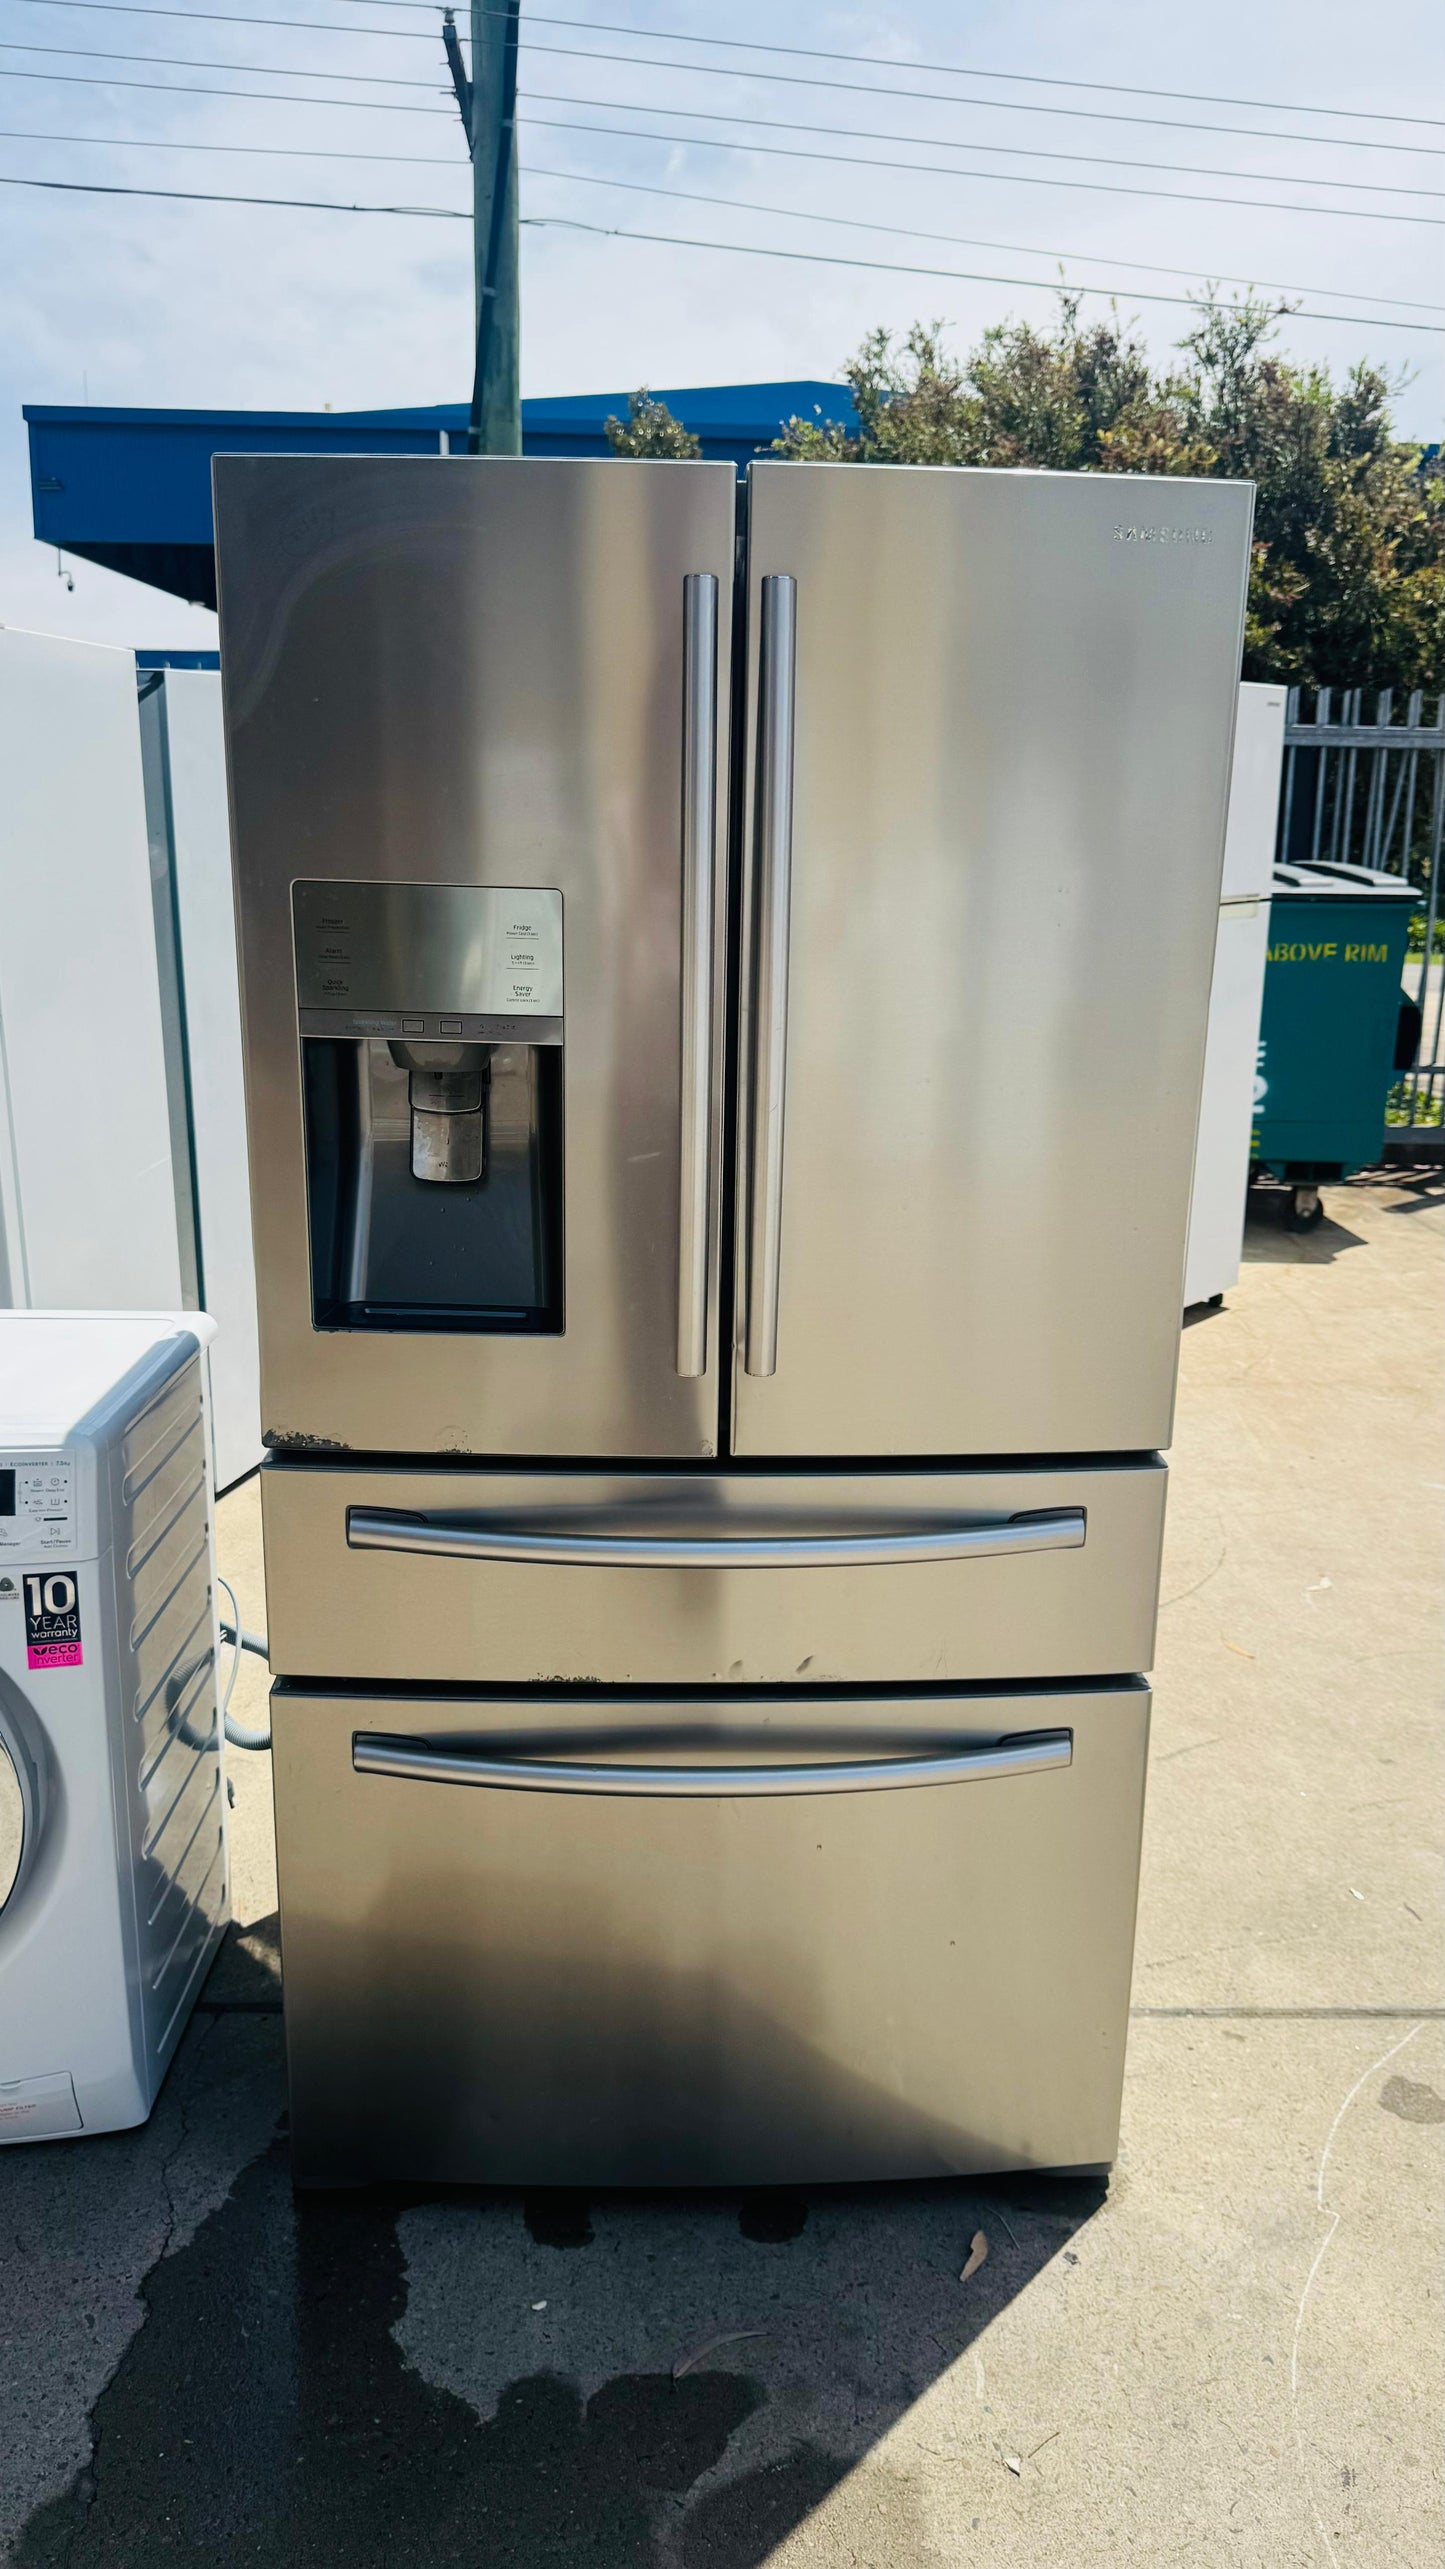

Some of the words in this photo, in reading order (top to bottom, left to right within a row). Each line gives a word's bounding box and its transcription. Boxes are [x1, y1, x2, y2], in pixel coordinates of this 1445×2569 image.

[1344, 944, 1388, 963] RIM
[26, 1574, 76, 1616] 10
[30, 1614, 78, 1631] YEAR
[31, 1627, 78, 1639] warranty
[48, 1643, 78, 1655] eco
[34, 1653, 78, 1665] inverter
